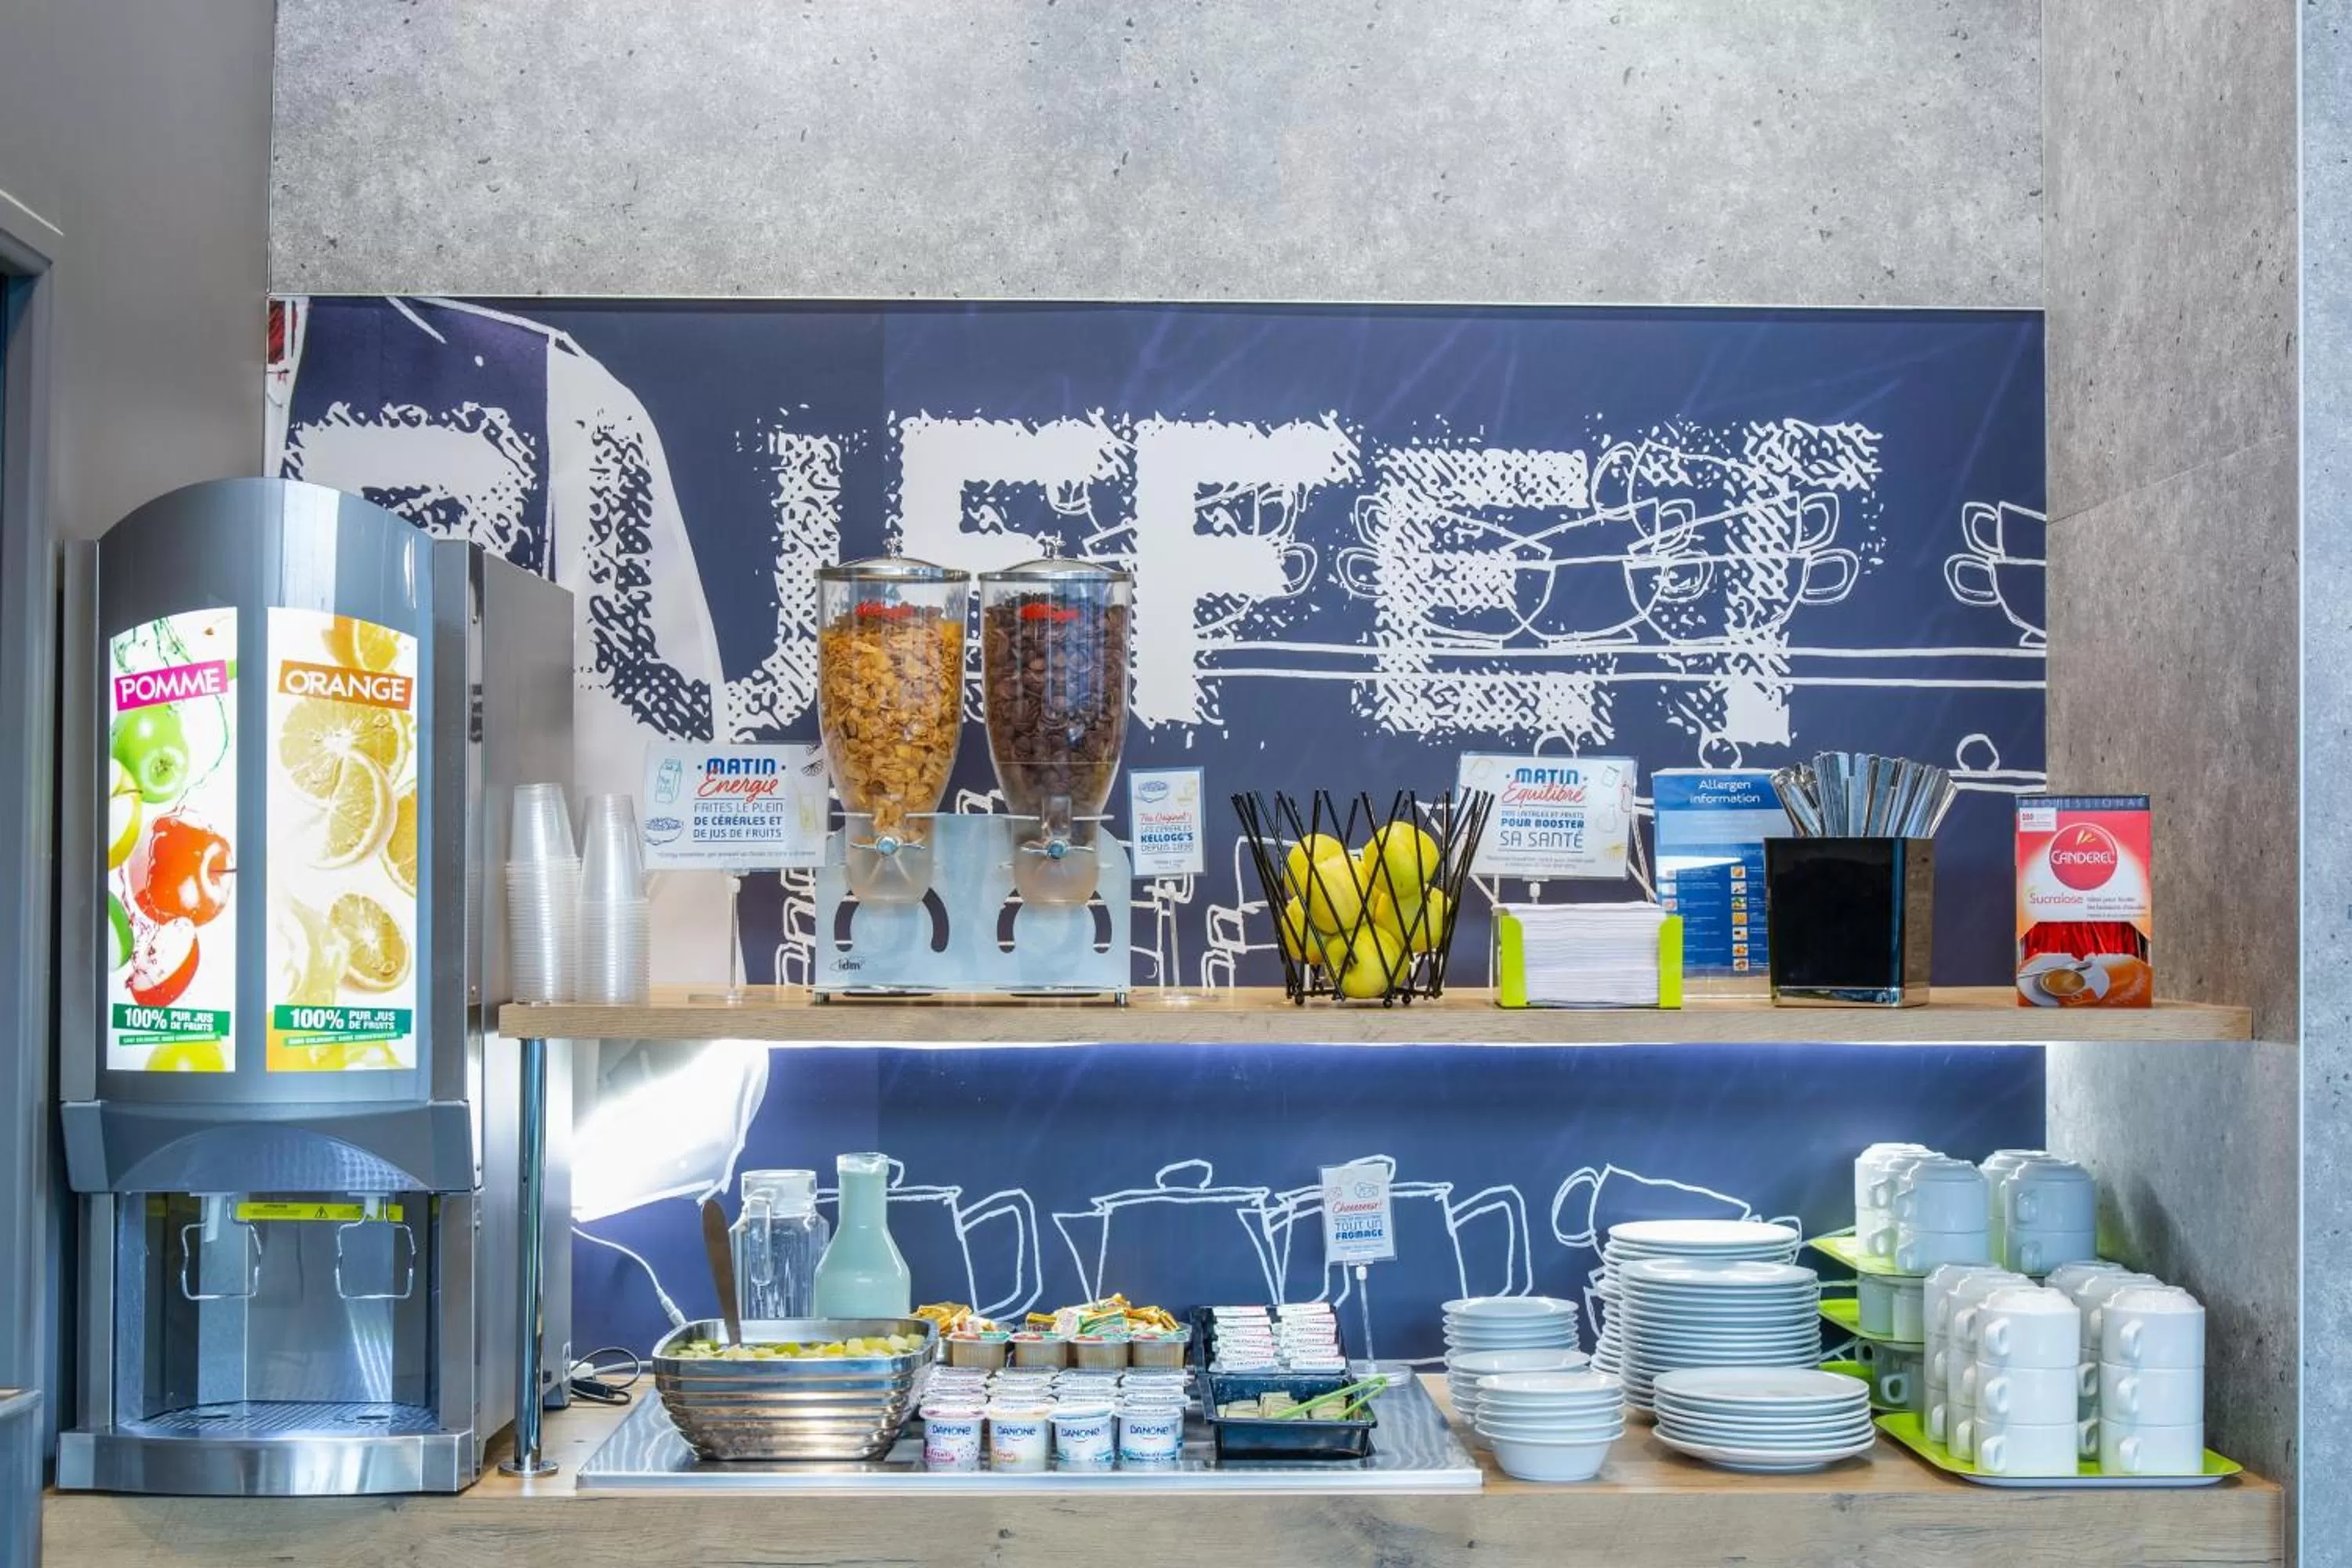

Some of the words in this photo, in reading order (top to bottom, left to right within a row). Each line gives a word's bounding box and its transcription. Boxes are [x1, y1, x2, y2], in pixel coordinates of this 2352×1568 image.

[120, 667, 220, 703] POMME
[285, 670, 406, 702] ORANGE
[706, 758, 776, 775] MATIN
[1515, 768, 1578, 785] MATIN
[1699, 779, 1751, 792] Allergen
[1690, 793, 1760, 803] Information
[694, 803, 732, 812] FAITES
[736, 803, 748, 812] LE
[753, 803, 783, 812] PLEIN
[694, 816, 708, 826] DE
[711, 814, 766, 826] CÉRÉALES
[769, 817, 782, 826] ET
[1501, 818, 1531, 827] POUR
[1535, 819, 1584, 829] BOOSTER
[694, 829, 706, 838] DE
[710, 829, 727, 839] JUS
[730, 829, 742, 838] DE
[746, 829, 782, 838] FRUITS
[1141, 832, 1193, 843] KELLOGG'S
[1499, 831, 1522, 846] SA
[1528, 831, 1583, 848] SANTÉ
[125, 1008, 167, 1029] 100%
[170, 1011, 191, 1022] PUR
[194, 1012, 214, 1023] JUS
[290, 1008, 344, 1029] 100%
[348, 1011, 371, 1020] PUR
[374, 1011, 395, 1022] JUS
[183, 1022, 213, 1031] FRUITS
[1335, 1229, 1383, 1240] FROMAGE
[932, 1425, 971, 1436] DANONE
[996, 1425, 1036, 1436] DANONE
[1061, 1427, 1100, 1437] DANONE
[1130, 1425, 1169, 1435] DANONE
